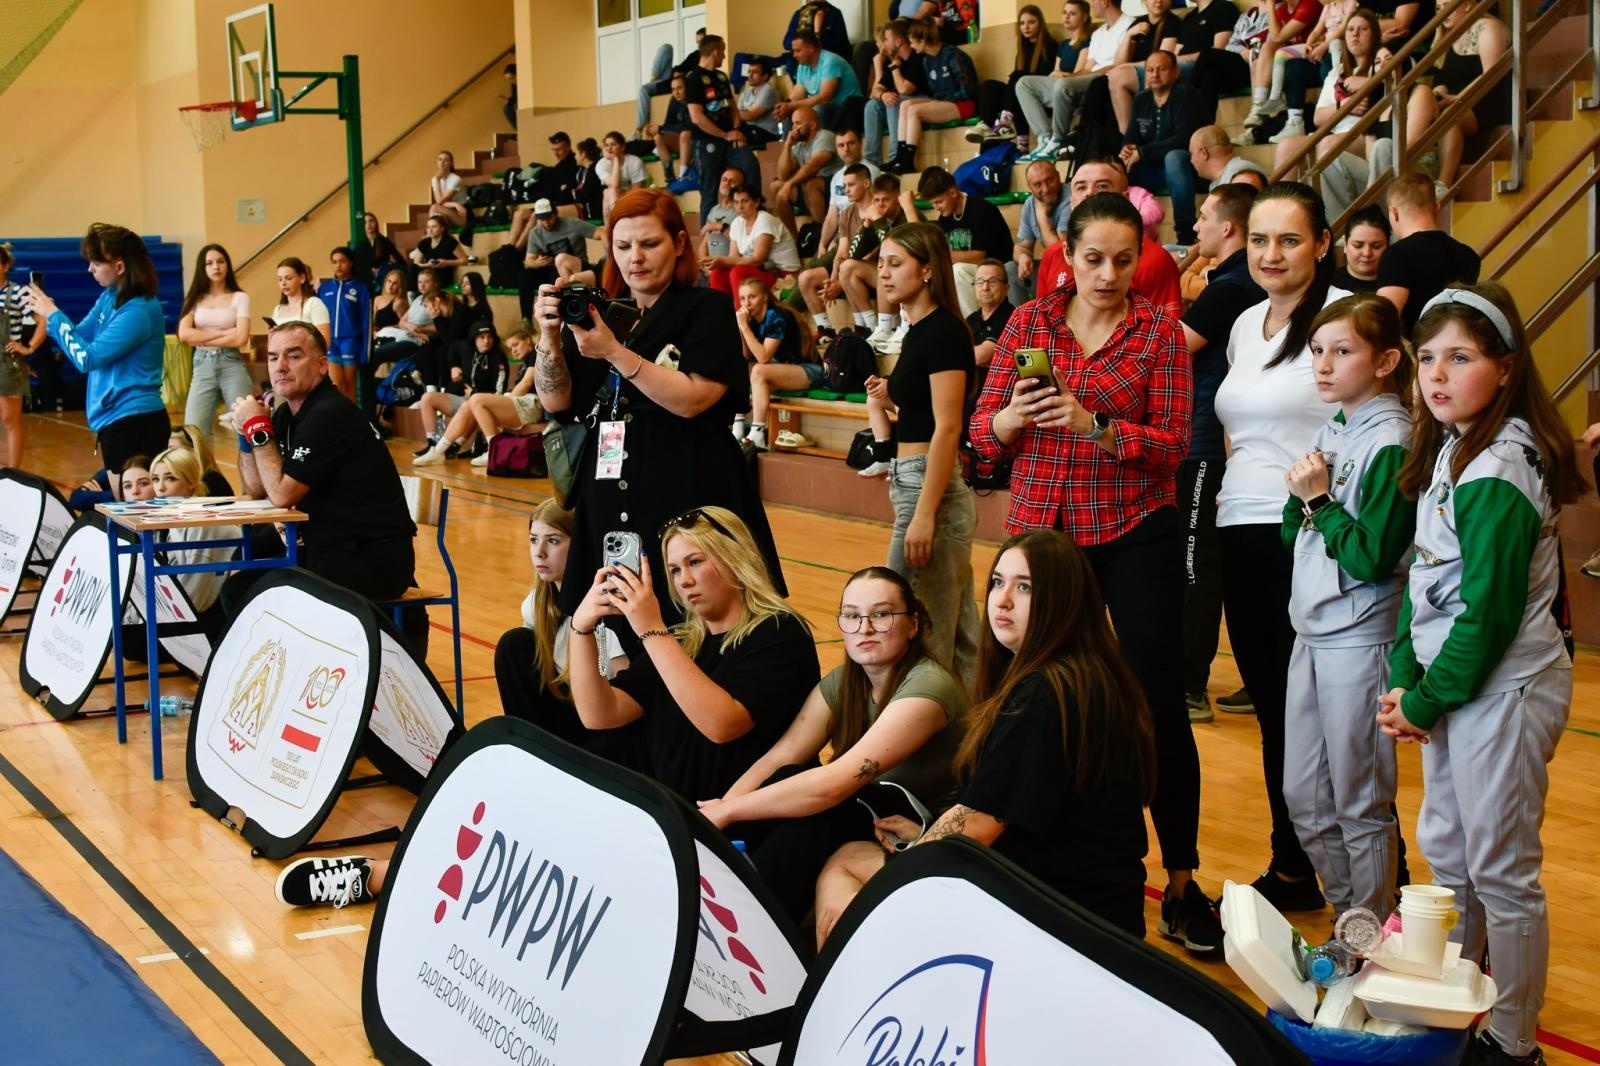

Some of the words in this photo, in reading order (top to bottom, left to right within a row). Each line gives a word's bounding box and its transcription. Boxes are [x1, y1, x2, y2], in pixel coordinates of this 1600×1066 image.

[1192, 461, 1207, 507] LAGERFELD
[1190, 507, 1199, 528] KARL
[1186, 535, 1196, 579] LAGERFELD
[60, 567, 110, 630] PWPW
[461, 829, 612, 992] PWPW
[416, 961, 471, 1016] PAPIERÓW
[467, 1000, 556, 1066] WARTOŚCIOW
[446, 943, 488, 991] POLSKA
[487, 973, 559, 1046] WYTWÓRNIA
[864, 1015, 966, 1066] Plki
